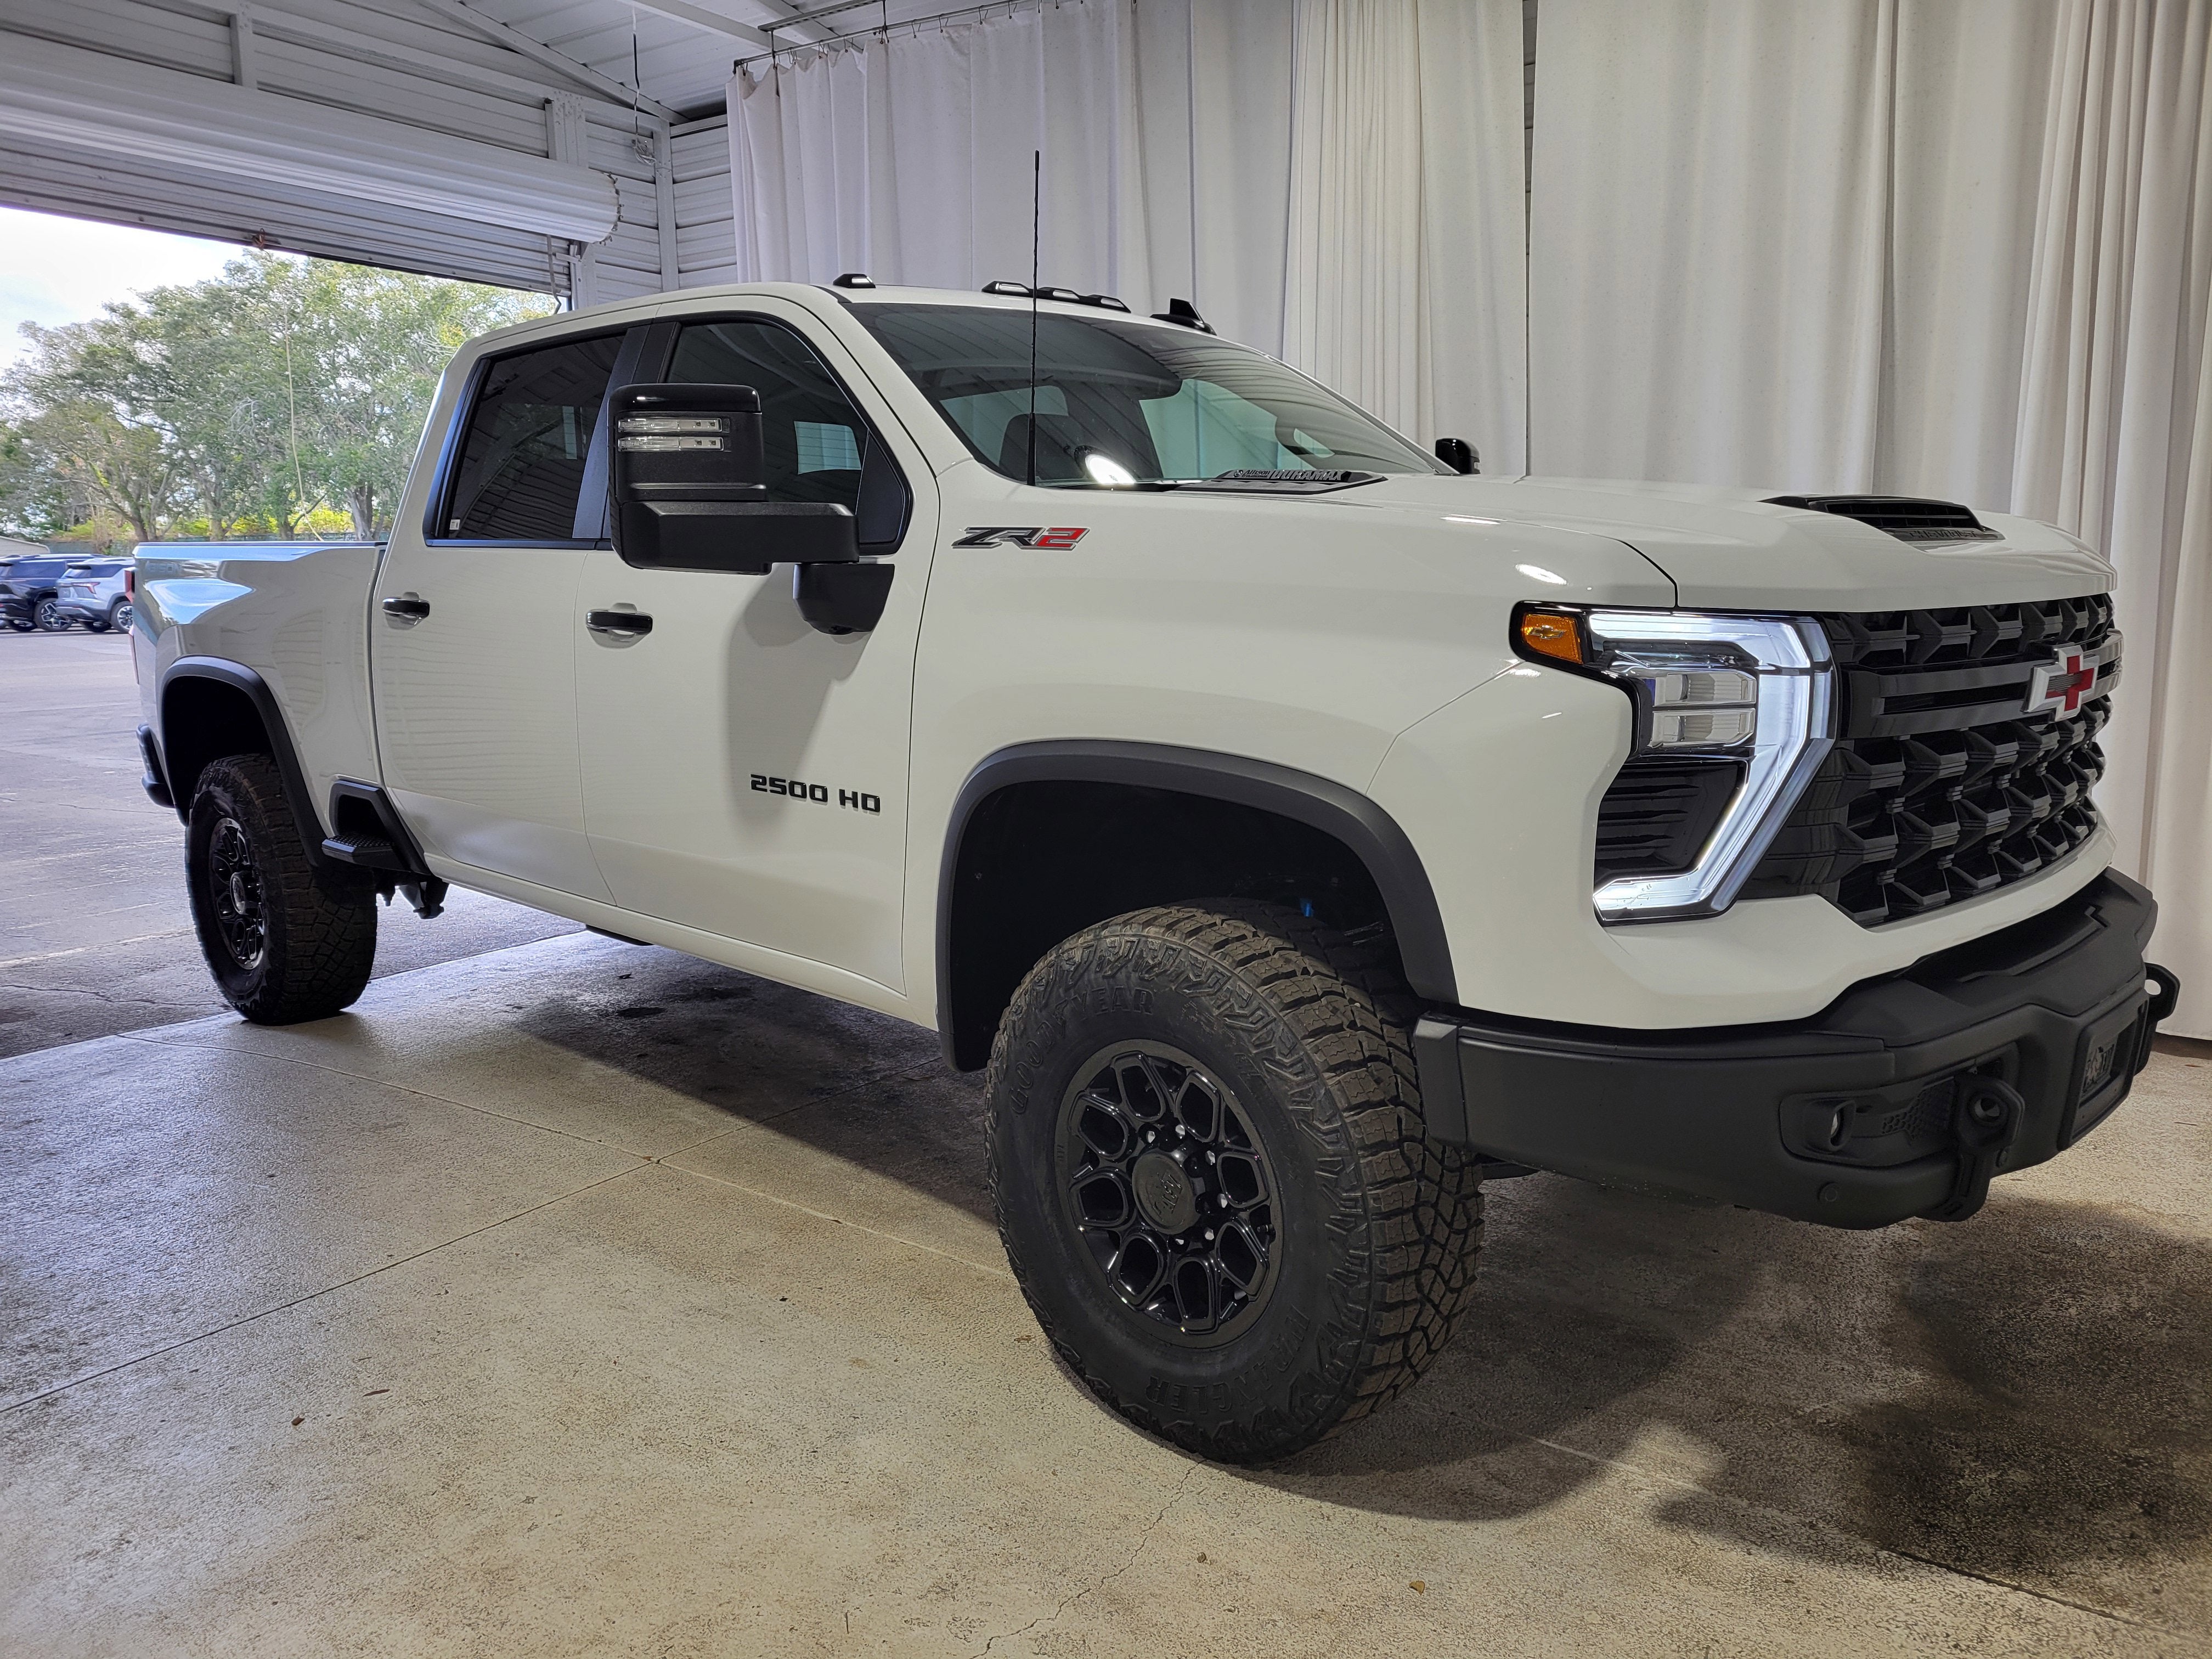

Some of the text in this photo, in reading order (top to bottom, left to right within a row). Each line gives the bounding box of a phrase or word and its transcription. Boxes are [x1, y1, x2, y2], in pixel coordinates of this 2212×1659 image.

[1271, 470, 1341, 480] DURAMAX
[951, 526, 1091, 551] ZR2
[750, 774, 881, 812] 2500 HD
[1008, 986, 1154, 1114] GOODYEAR
[1145, 1304, 1311, 1414] WRANGLER
